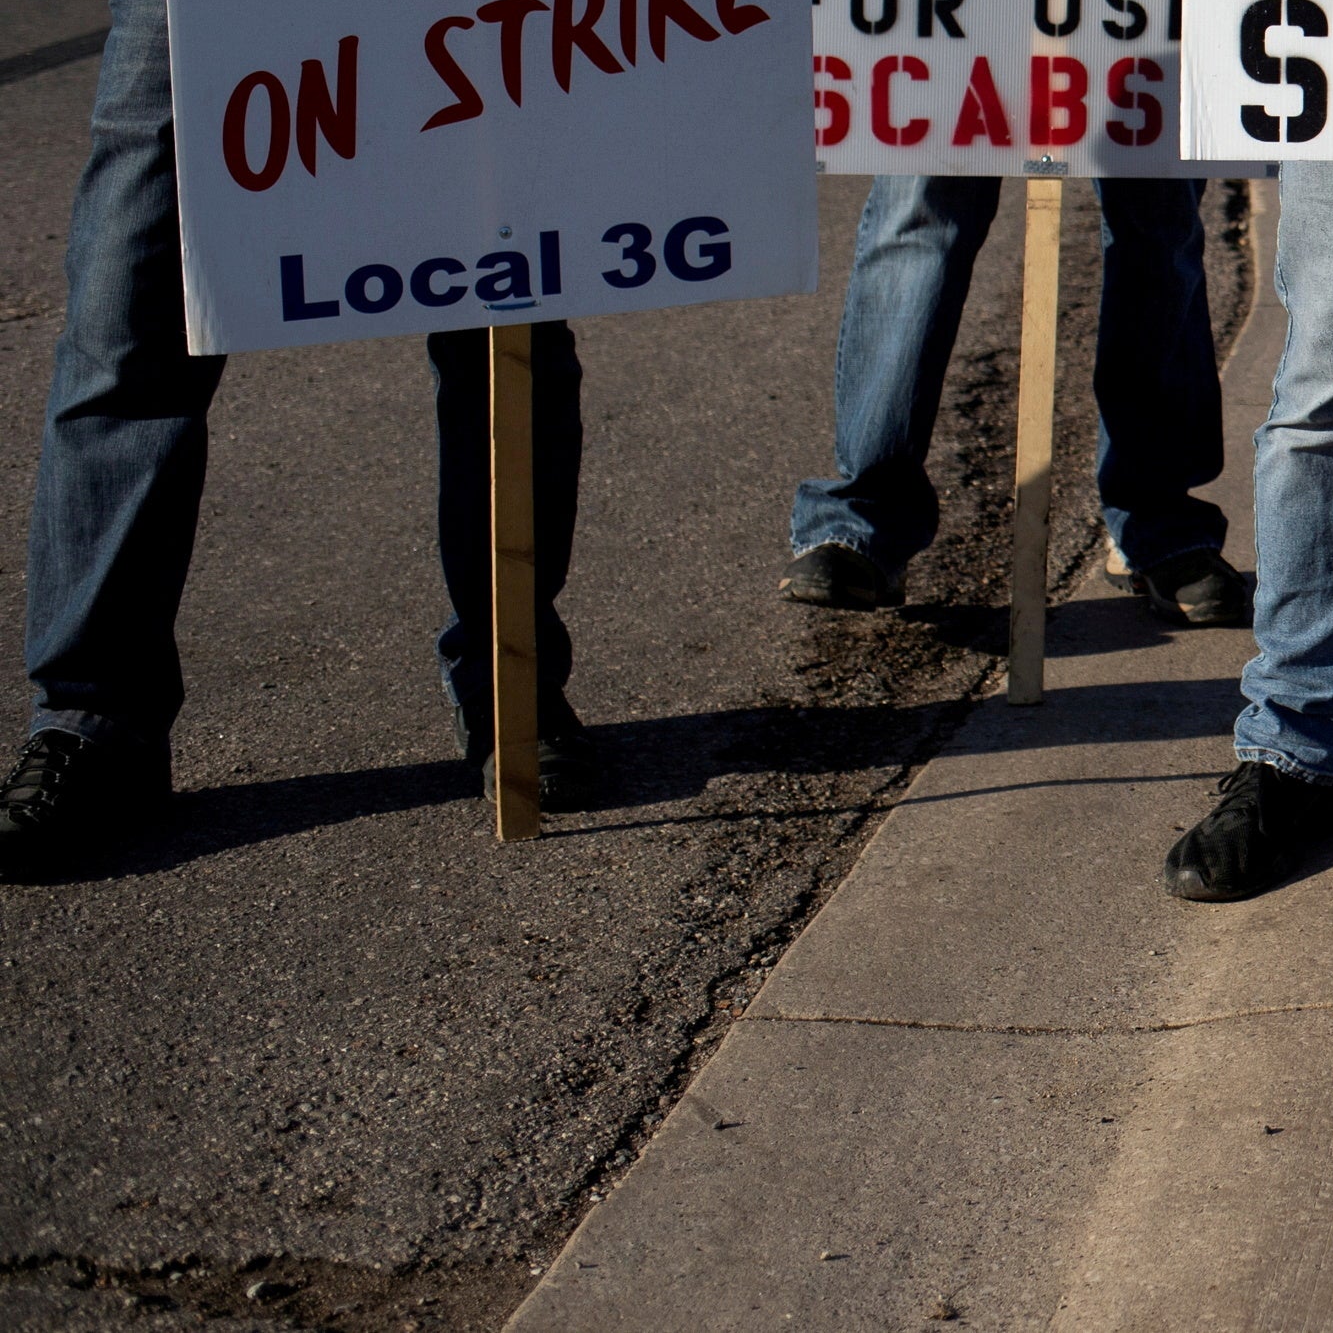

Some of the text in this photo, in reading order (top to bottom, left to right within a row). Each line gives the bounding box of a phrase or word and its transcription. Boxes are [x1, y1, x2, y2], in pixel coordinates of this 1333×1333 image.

[221, 34, 359, 193] ON
[813, 54, 1165, 147] SCABS
[280, 215, 733, 323] Local 3G
